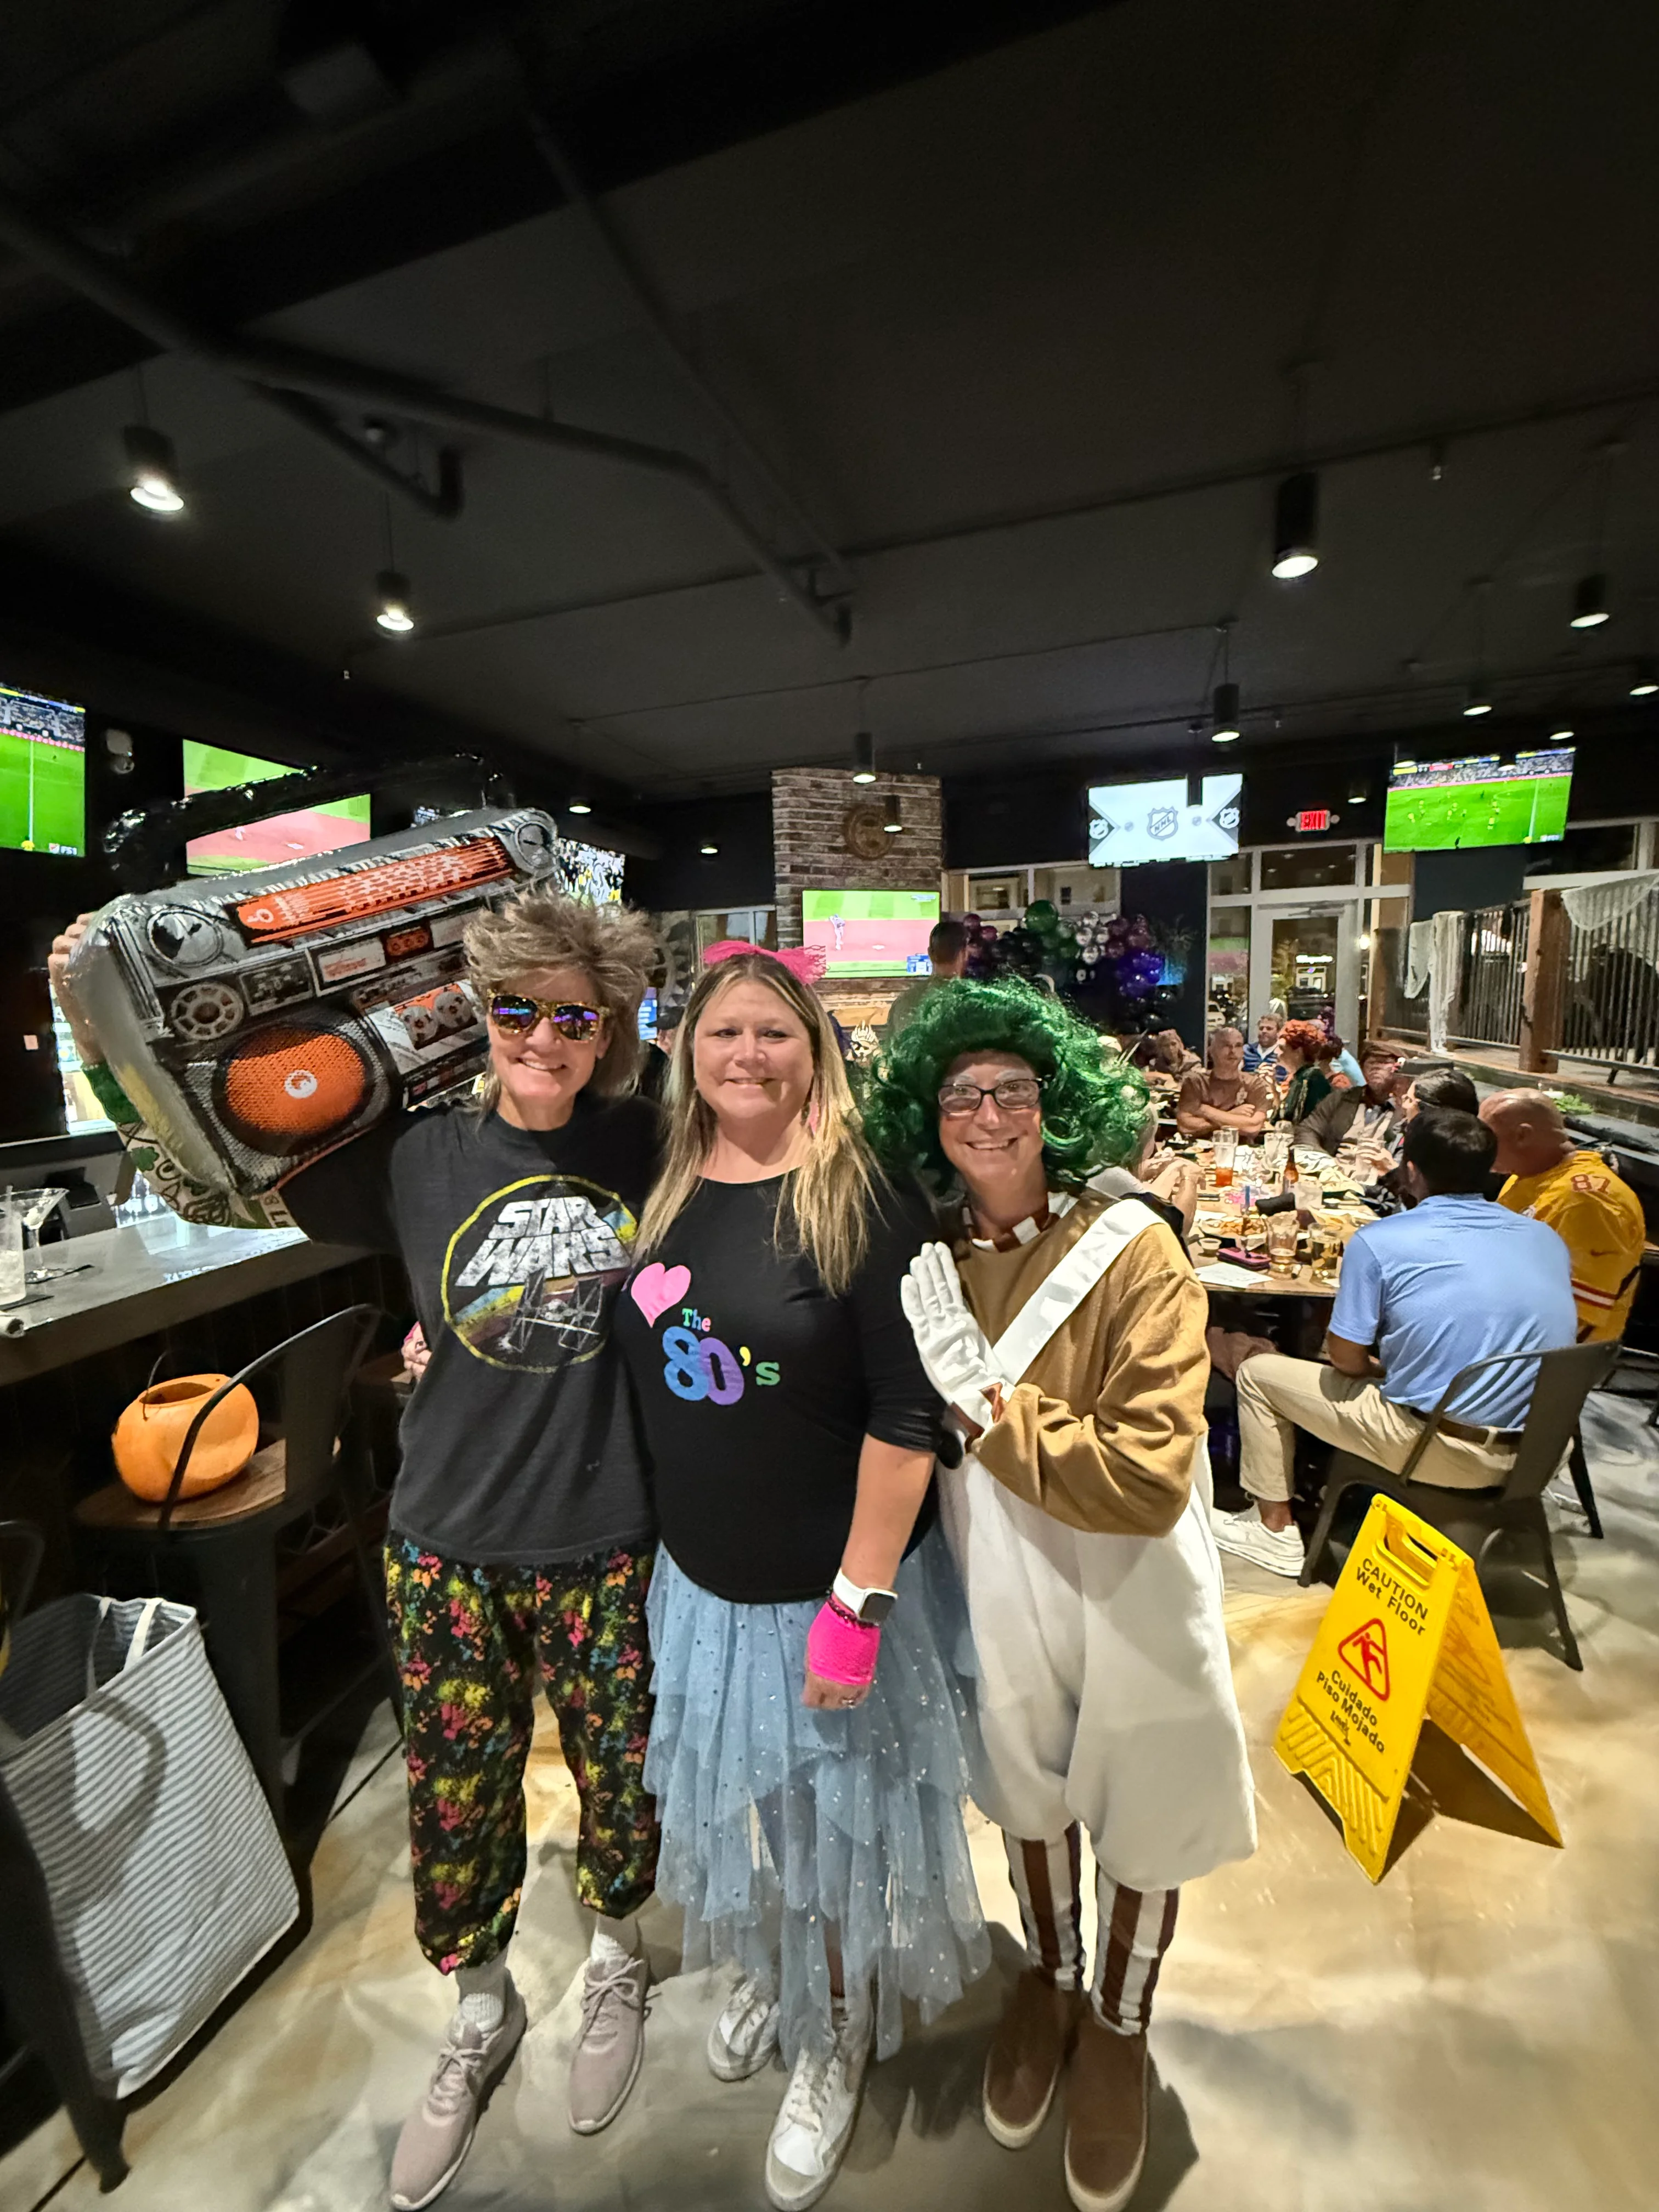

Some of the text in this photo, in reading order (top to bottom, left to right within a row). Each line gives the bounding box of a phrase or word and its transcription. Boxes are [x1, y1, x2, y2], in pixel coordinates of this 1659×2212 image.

[1154, 816, 1172, 833] NHL
[1301, 810, 1327, 831] EXIT
[488, 1195, 608, 1240] STAR
[454, 1223, 631, 1288] WARS
[682, 1308, 712, 1332] The
[662, 1325, 781, 1406] 80's
[1357, 1566, 1382, 1599] Wet
[1387, 1595, 1426, 1635] Floor
[1362, 1558, 1428, 1620] CAUTION
[1317, 1671, 1385, 1753] Piso Mojado
[1331, 1670, 1377, 1726] Cuidado
